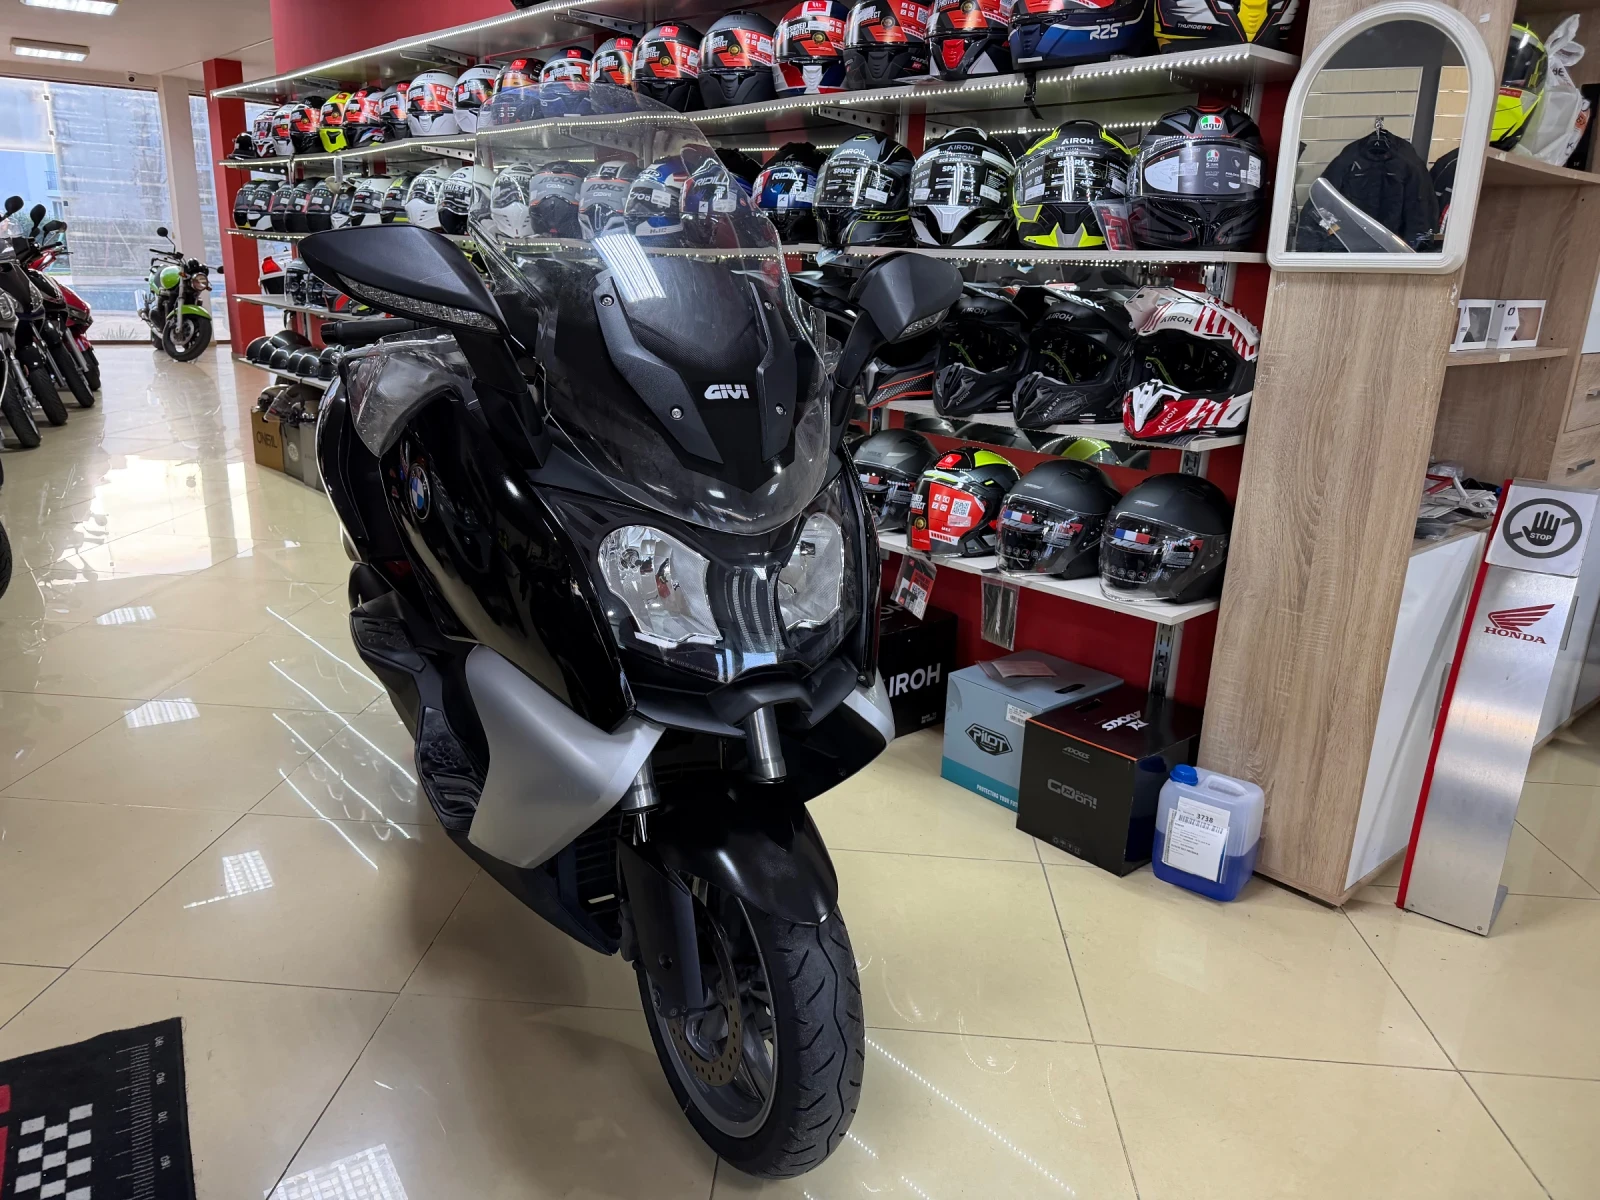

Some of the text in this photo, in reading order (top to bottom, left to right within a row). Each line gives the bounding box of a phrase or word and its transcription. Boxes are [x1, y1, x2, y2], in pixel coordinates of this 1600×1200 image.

[1025, 164, 1044, 177] AIROH
[961, 306, 988, 316] AIROH
[1045, 312, 1074, 322] AIROH
[1160, 315, 1193, 325] AIROH
[704, 384, 749, 399] GIVI
[1158, 407, 1179, 432] AIROH
[1529, 532, 1552, 541] STOP
[1484, 626, 1547, 645] HONDA
[885, 662, 941, 698] IROH
[1196, 813, 1214, 823] 3738
